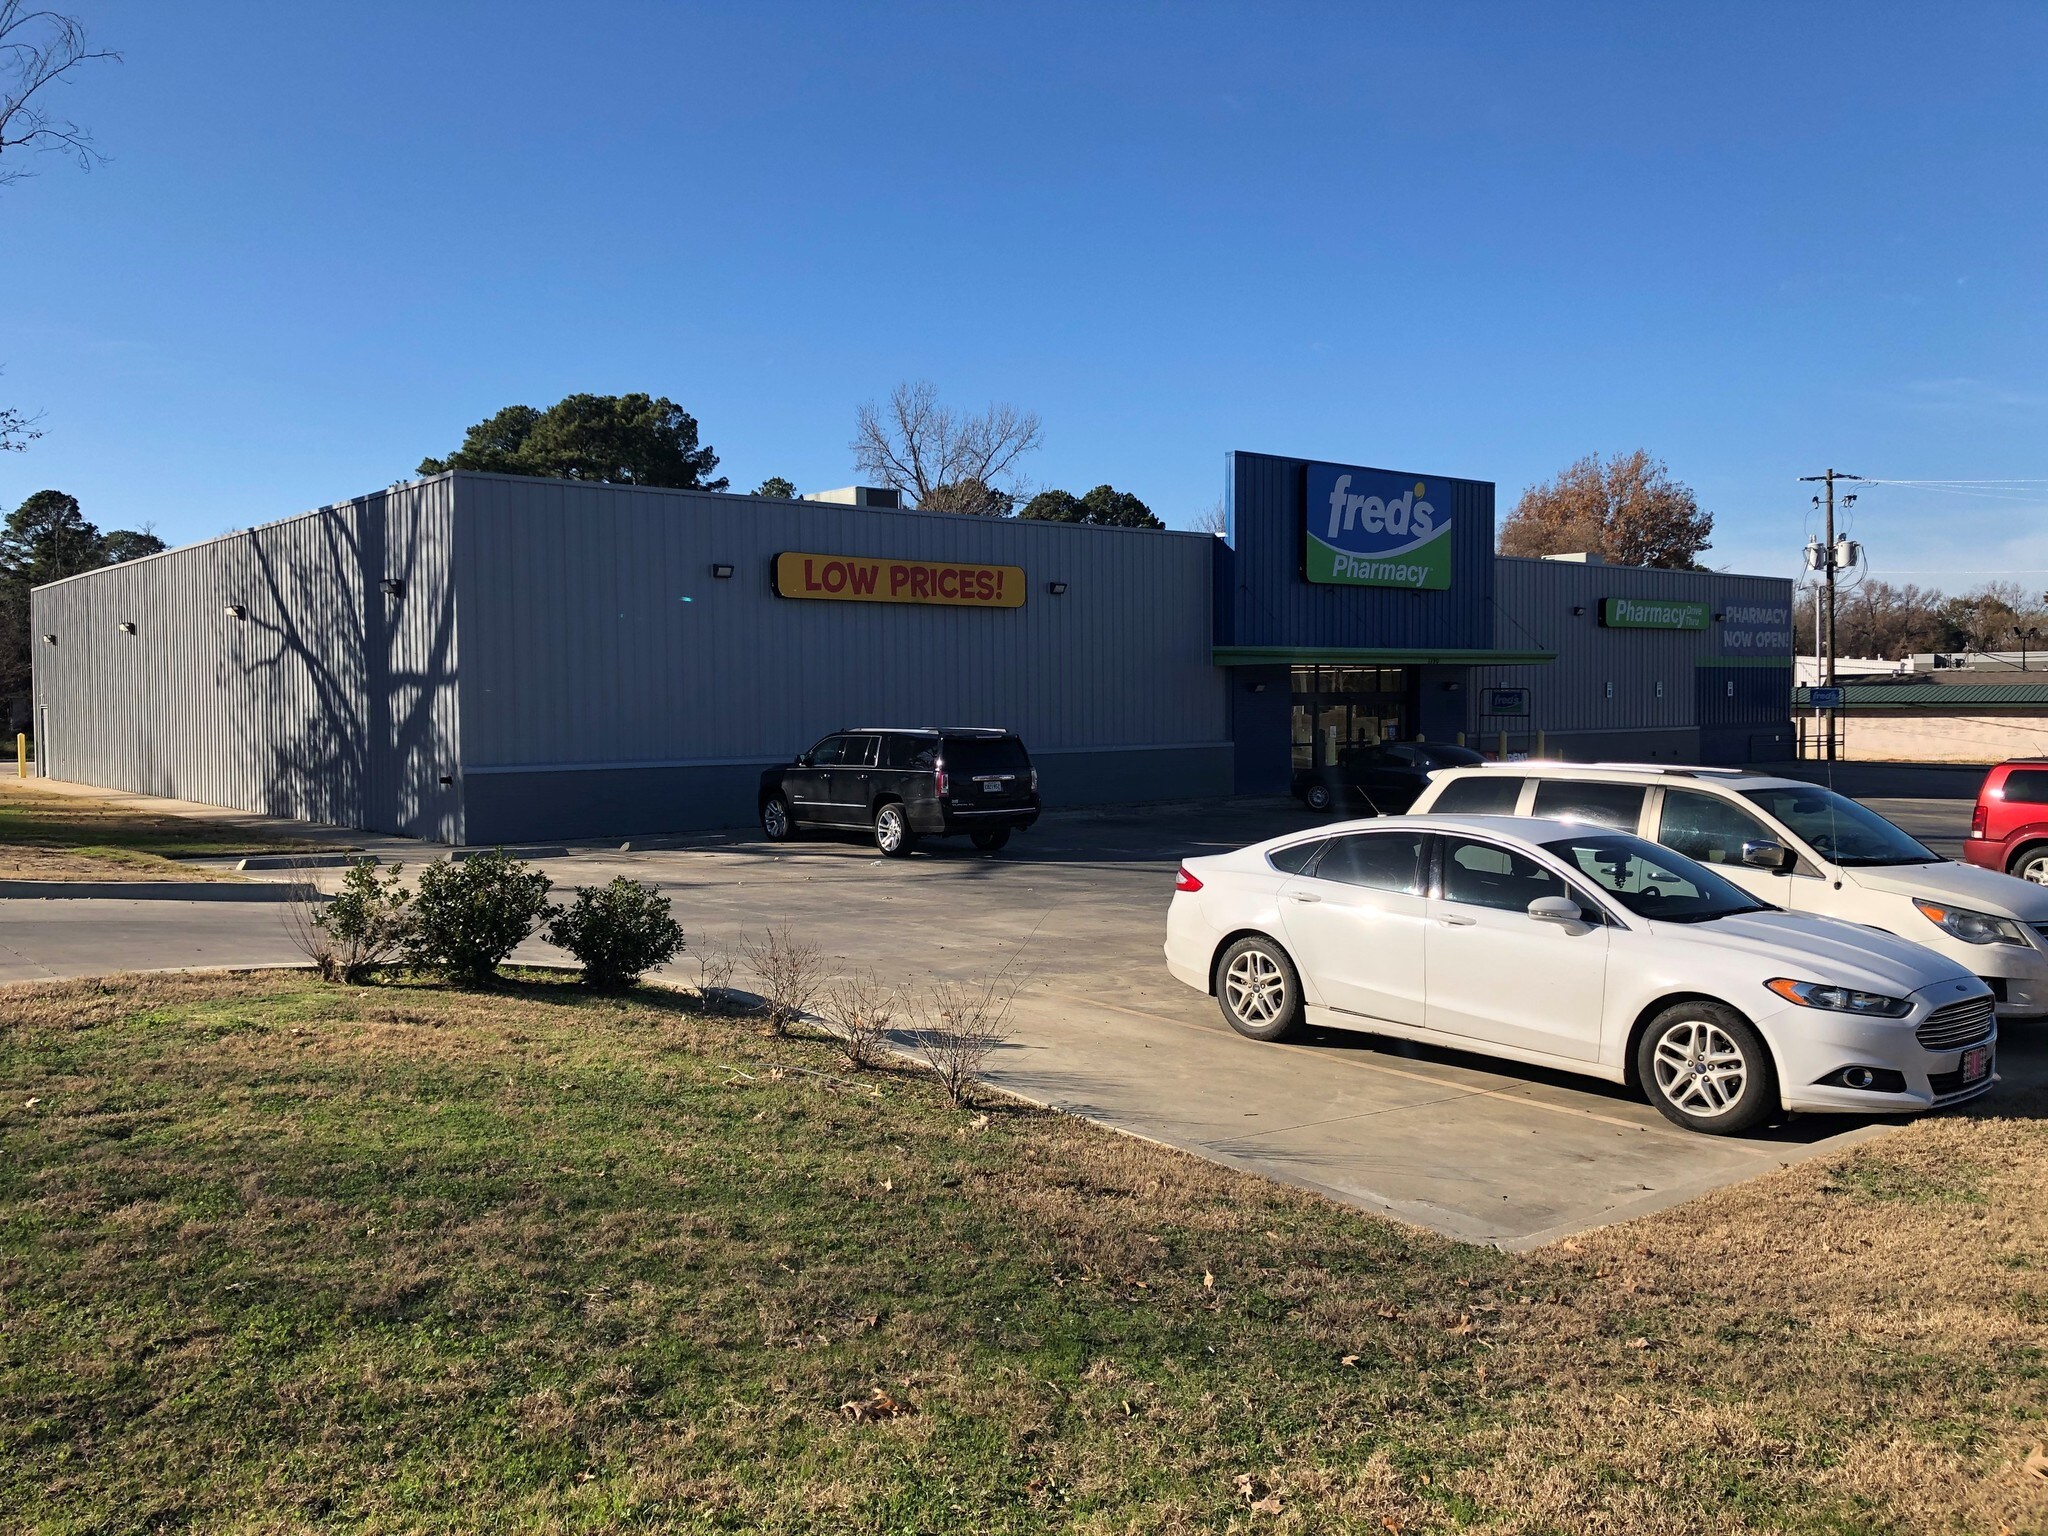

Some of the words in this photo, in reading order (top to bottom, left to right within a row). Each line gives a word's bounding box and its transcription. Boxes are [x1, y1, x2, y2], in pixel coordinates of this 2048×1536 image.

[1328, 474, 1435, 539] fred's
[804, 559, 879, 595] LOW
[889, 565, 1004, 601] PRICES!
[1332, 555, 1428, 587] Pharmacy
[1615, 600, 1686, 628] Pharmacy
[1726, 606, 1788, 625] PHARMACY
[1724, 631, 1753, 648] NOW
[1756, 632, 1789, 648] OPEN!
